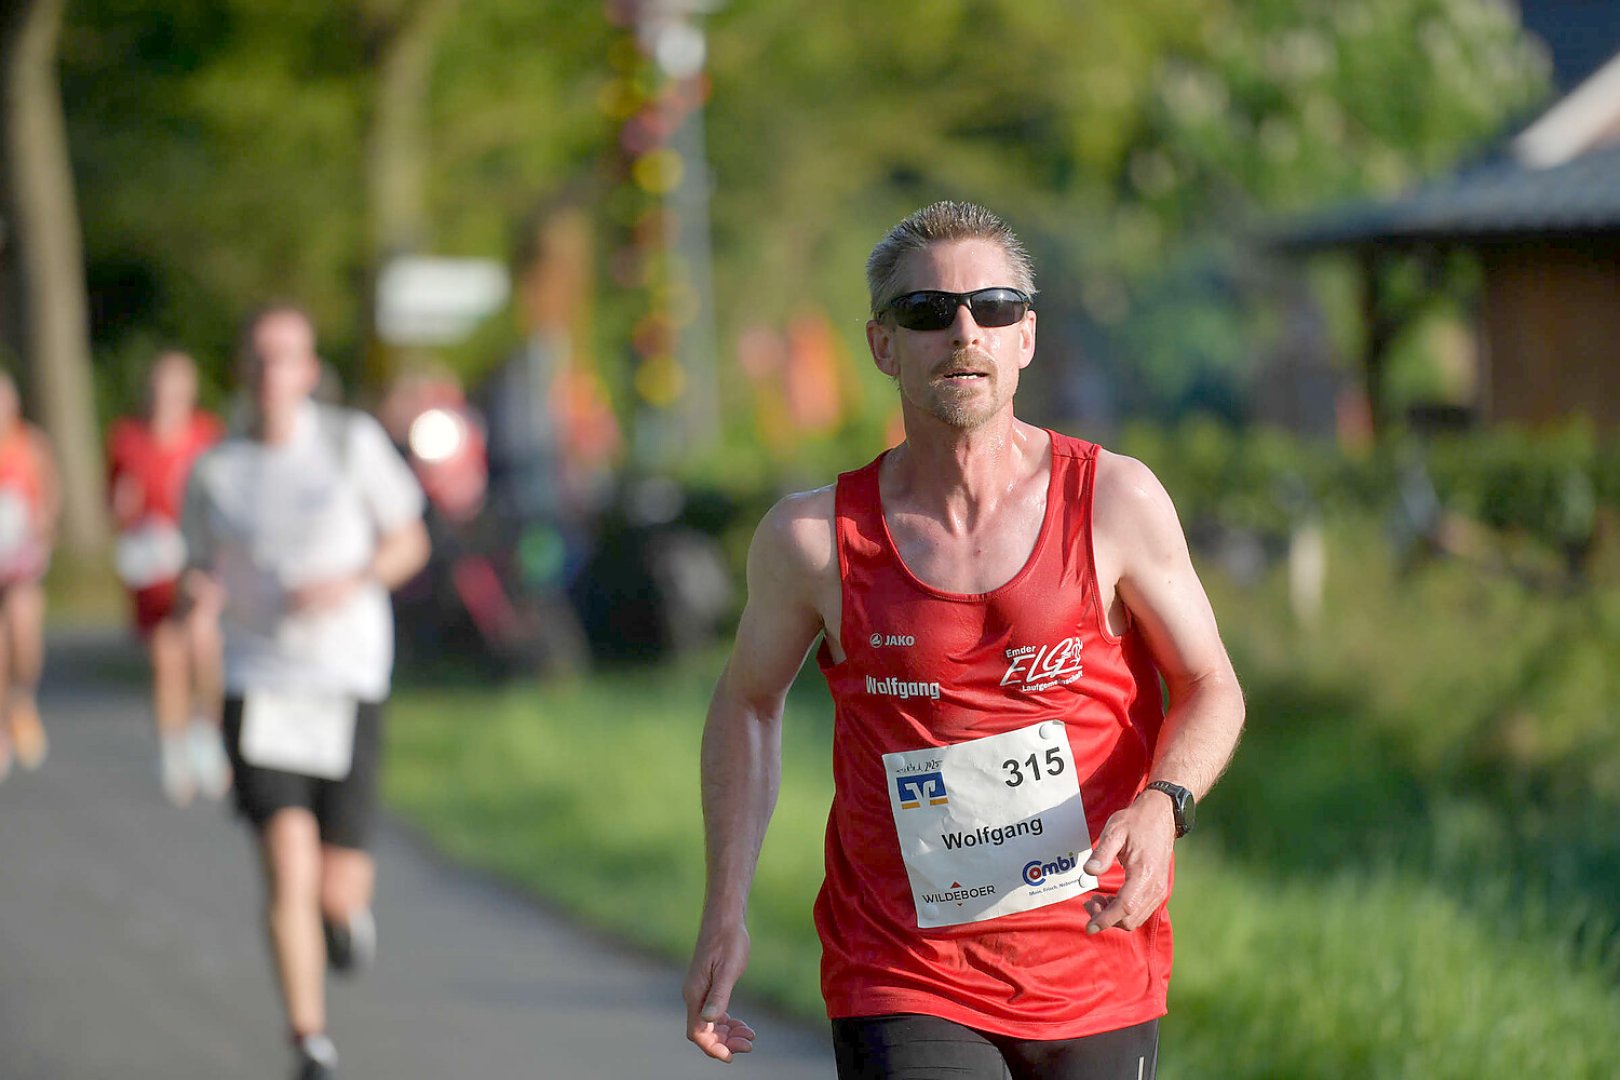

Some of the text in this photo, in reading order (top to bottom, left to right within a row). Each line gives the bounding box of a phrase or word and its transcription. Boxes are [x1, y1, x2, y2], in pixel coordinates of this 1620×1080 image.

[884, 635, 915, 646] JAKO
[1005, 645, 1036, 658] Emder
[865, 674, 940, 700] Wolfgang
[1002, 746, 1066, 788] 315
[942, 817, 1044, 851] Wolfgang
[1022, 851, 1077, 887] Combi
[922, 884, 996, 904] WILDEBOER
